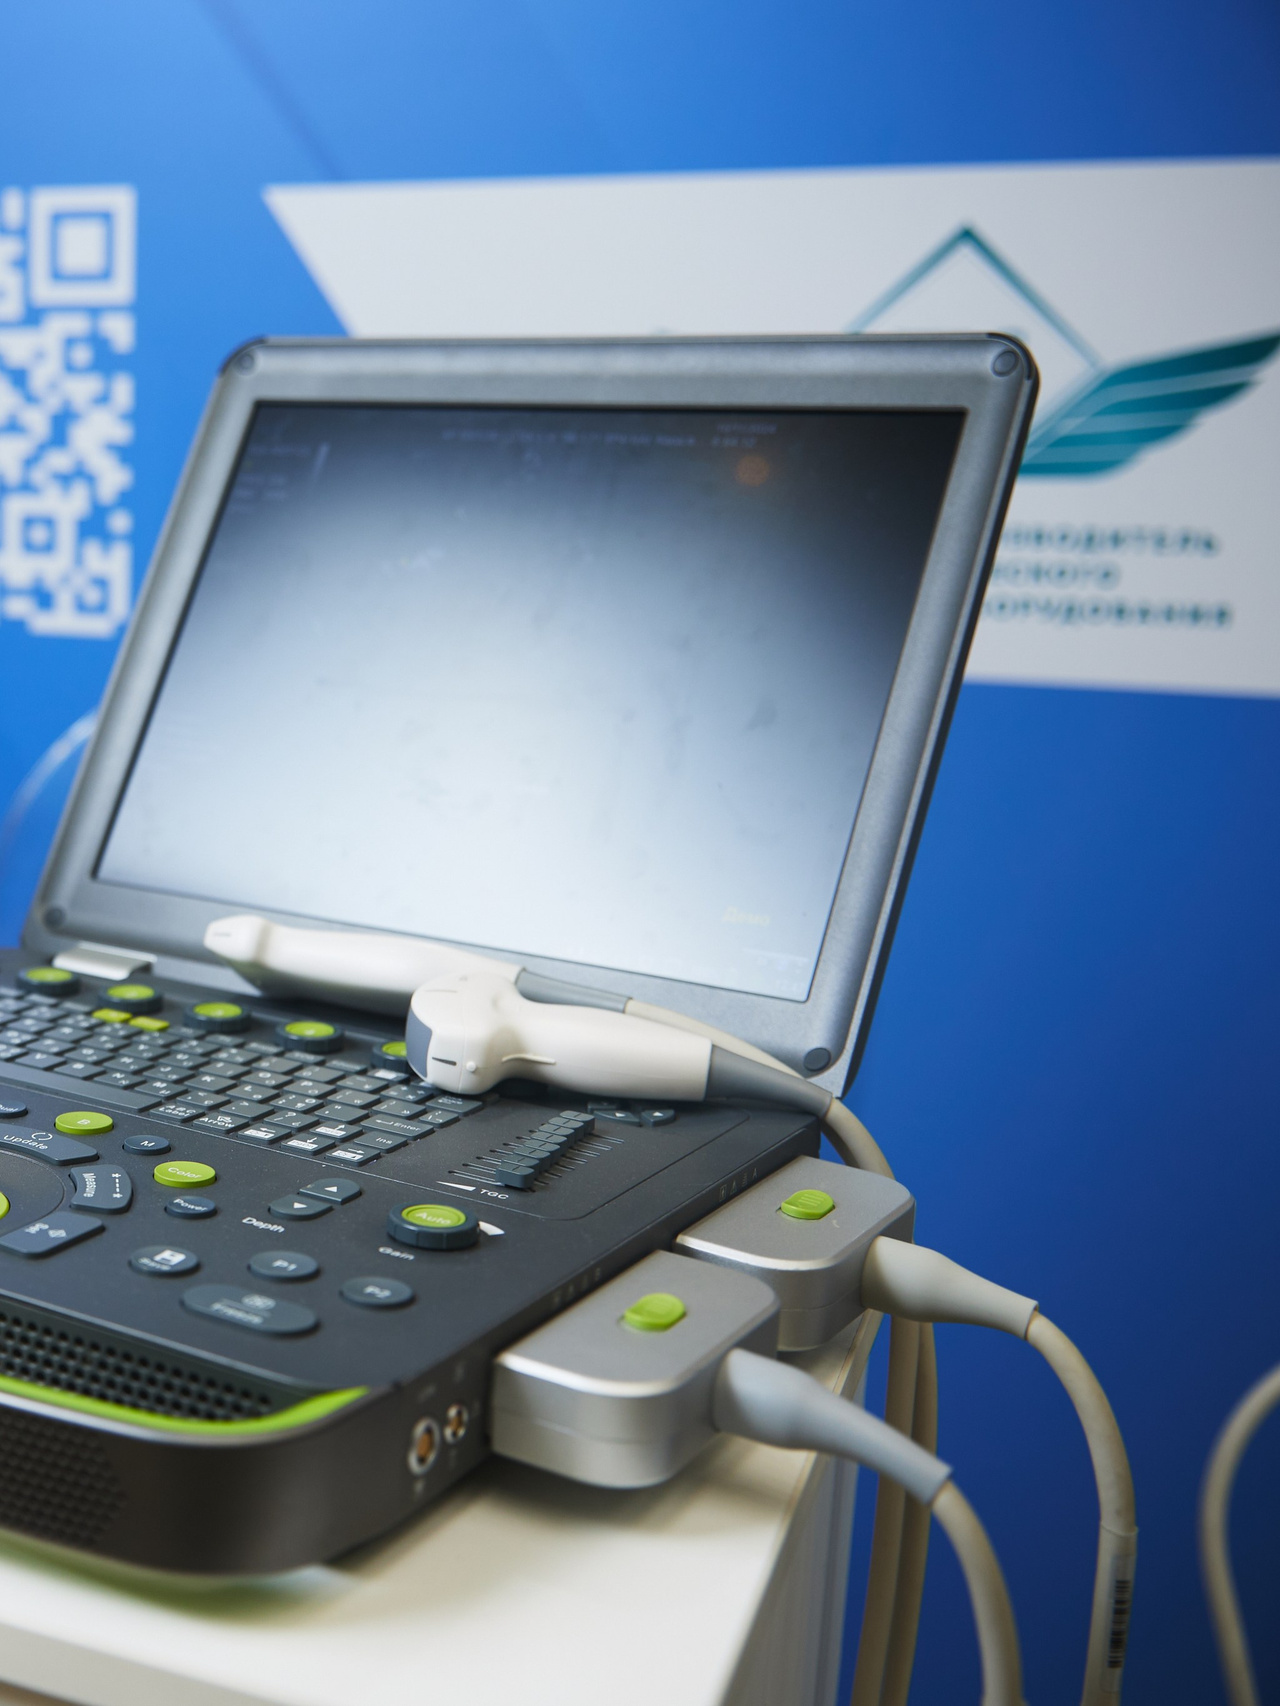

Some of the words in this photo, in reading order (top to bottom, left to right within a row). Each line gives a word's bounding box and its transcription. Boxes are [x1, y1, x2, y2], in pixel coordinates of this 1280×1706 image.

[76, 1118, 91, 1126] B
[199, 1116, 236, 1128] Arrow
[393, 1122, 421, 1132] Enter
[3, 1134, 49, 1151] Update
[140, 1140, 156, 1148] M
[167, 1167, 203, 1180] Color
[82, 1172, 96, 1198] Measure
[479, 1188, 510, 1201] TGC
[172, 1198, 209, 1213] Power
[241, 1216, 286, 1234] Depth
[414, 1211, 454, 1227] Auto
[377, 1246, 416, 1262] Gain
